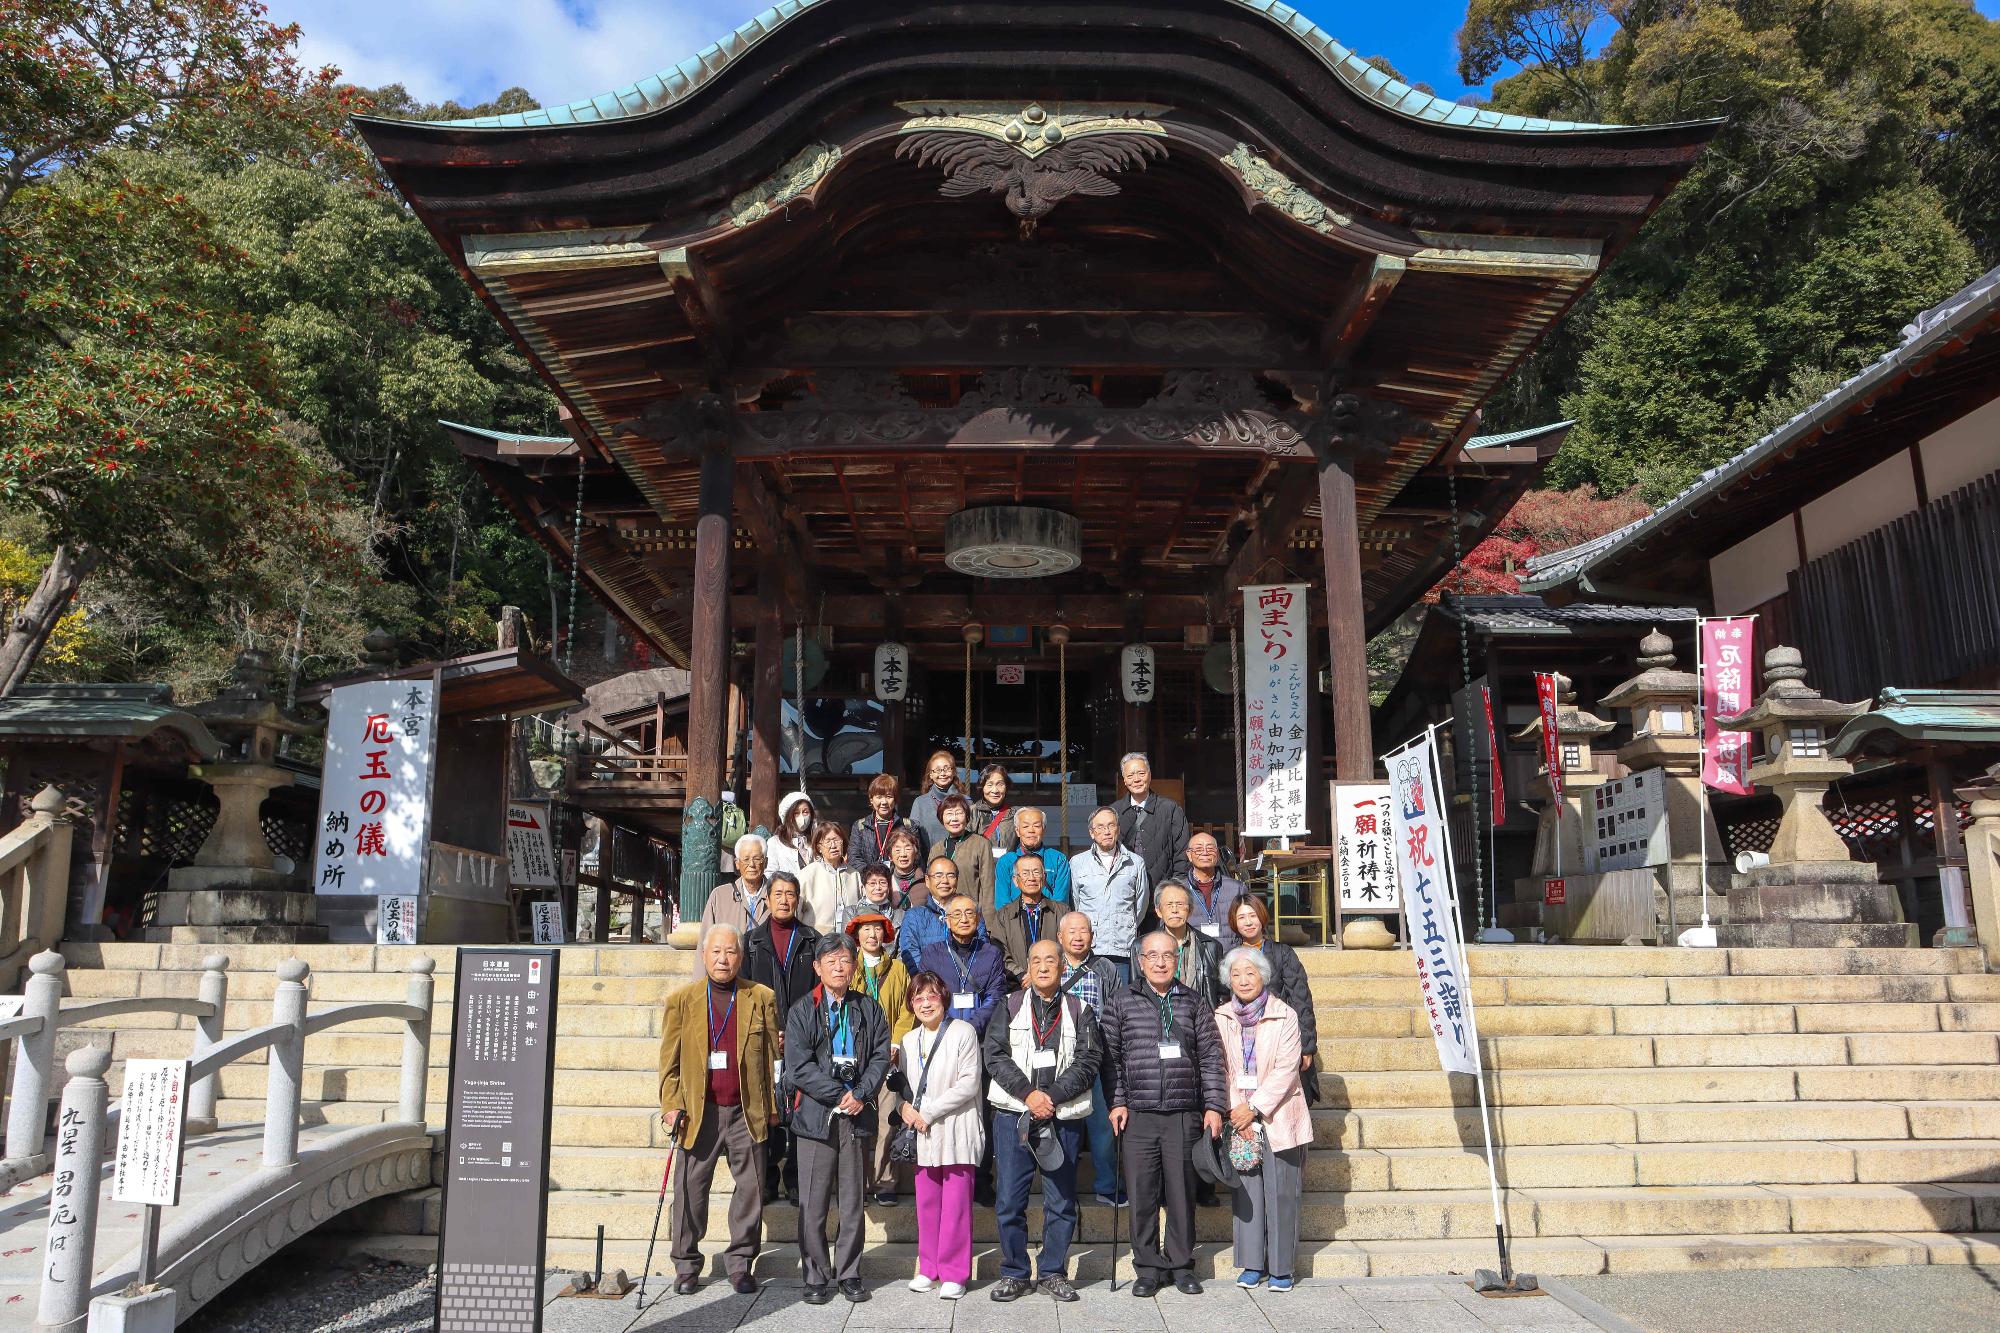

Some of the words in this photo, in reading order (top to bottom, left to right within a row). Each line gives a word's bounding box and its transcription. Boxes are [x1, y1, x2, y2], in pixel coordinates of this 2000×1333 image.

[1258, 586, 1294, 661] 両まいり
[402, 686, 426, 737] 本宮
[881, 656, 903, 694] 本宮
[1130, 658, 1151, 696] 本宮
[354, 713, 394, 857] 厄玉の儀
[1248, 699, 1265, 828] 心願成就の参詣
[1267, 723, 1285, 830] 由加神社本宮
[1287, 723, 1305, 829] 金刀比羅宮
[321, 811, 349, 889] 納め所
[1353, 799, 1381, 903] 一願祈祷木
[386, 898, 401, 942] 厄玉の儀
[538, 904, 552, 943] 厄玉の儀
[525, 990, 536, 1046] 由加神社
[1416, 956, 1443, 1037] 由加神社本宮
